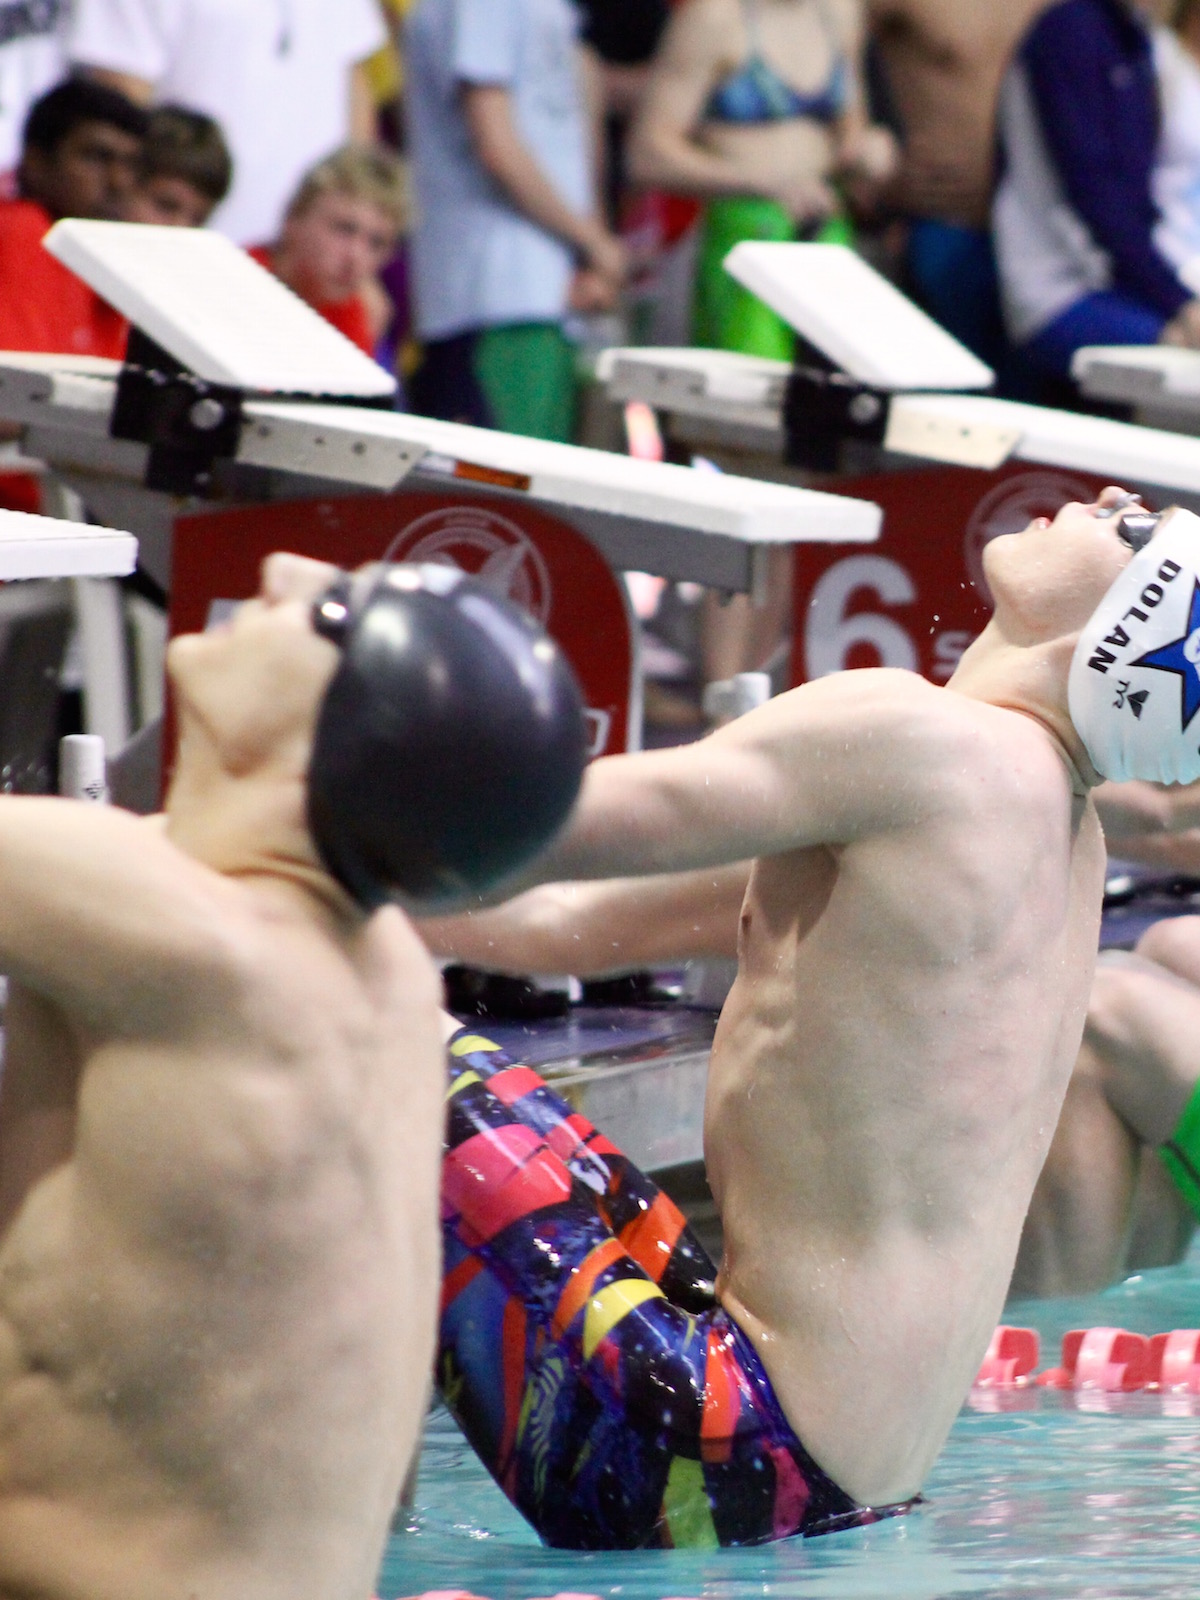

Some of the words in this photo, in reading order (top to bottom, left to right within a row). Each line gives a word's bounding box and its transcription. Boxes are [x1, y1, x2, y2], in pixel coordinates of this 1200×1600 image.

[806, 554, 918, 682] 6
[1088, 559, 1182, 674] DOLAN
[1112, 680, 1131, 710] TYR
